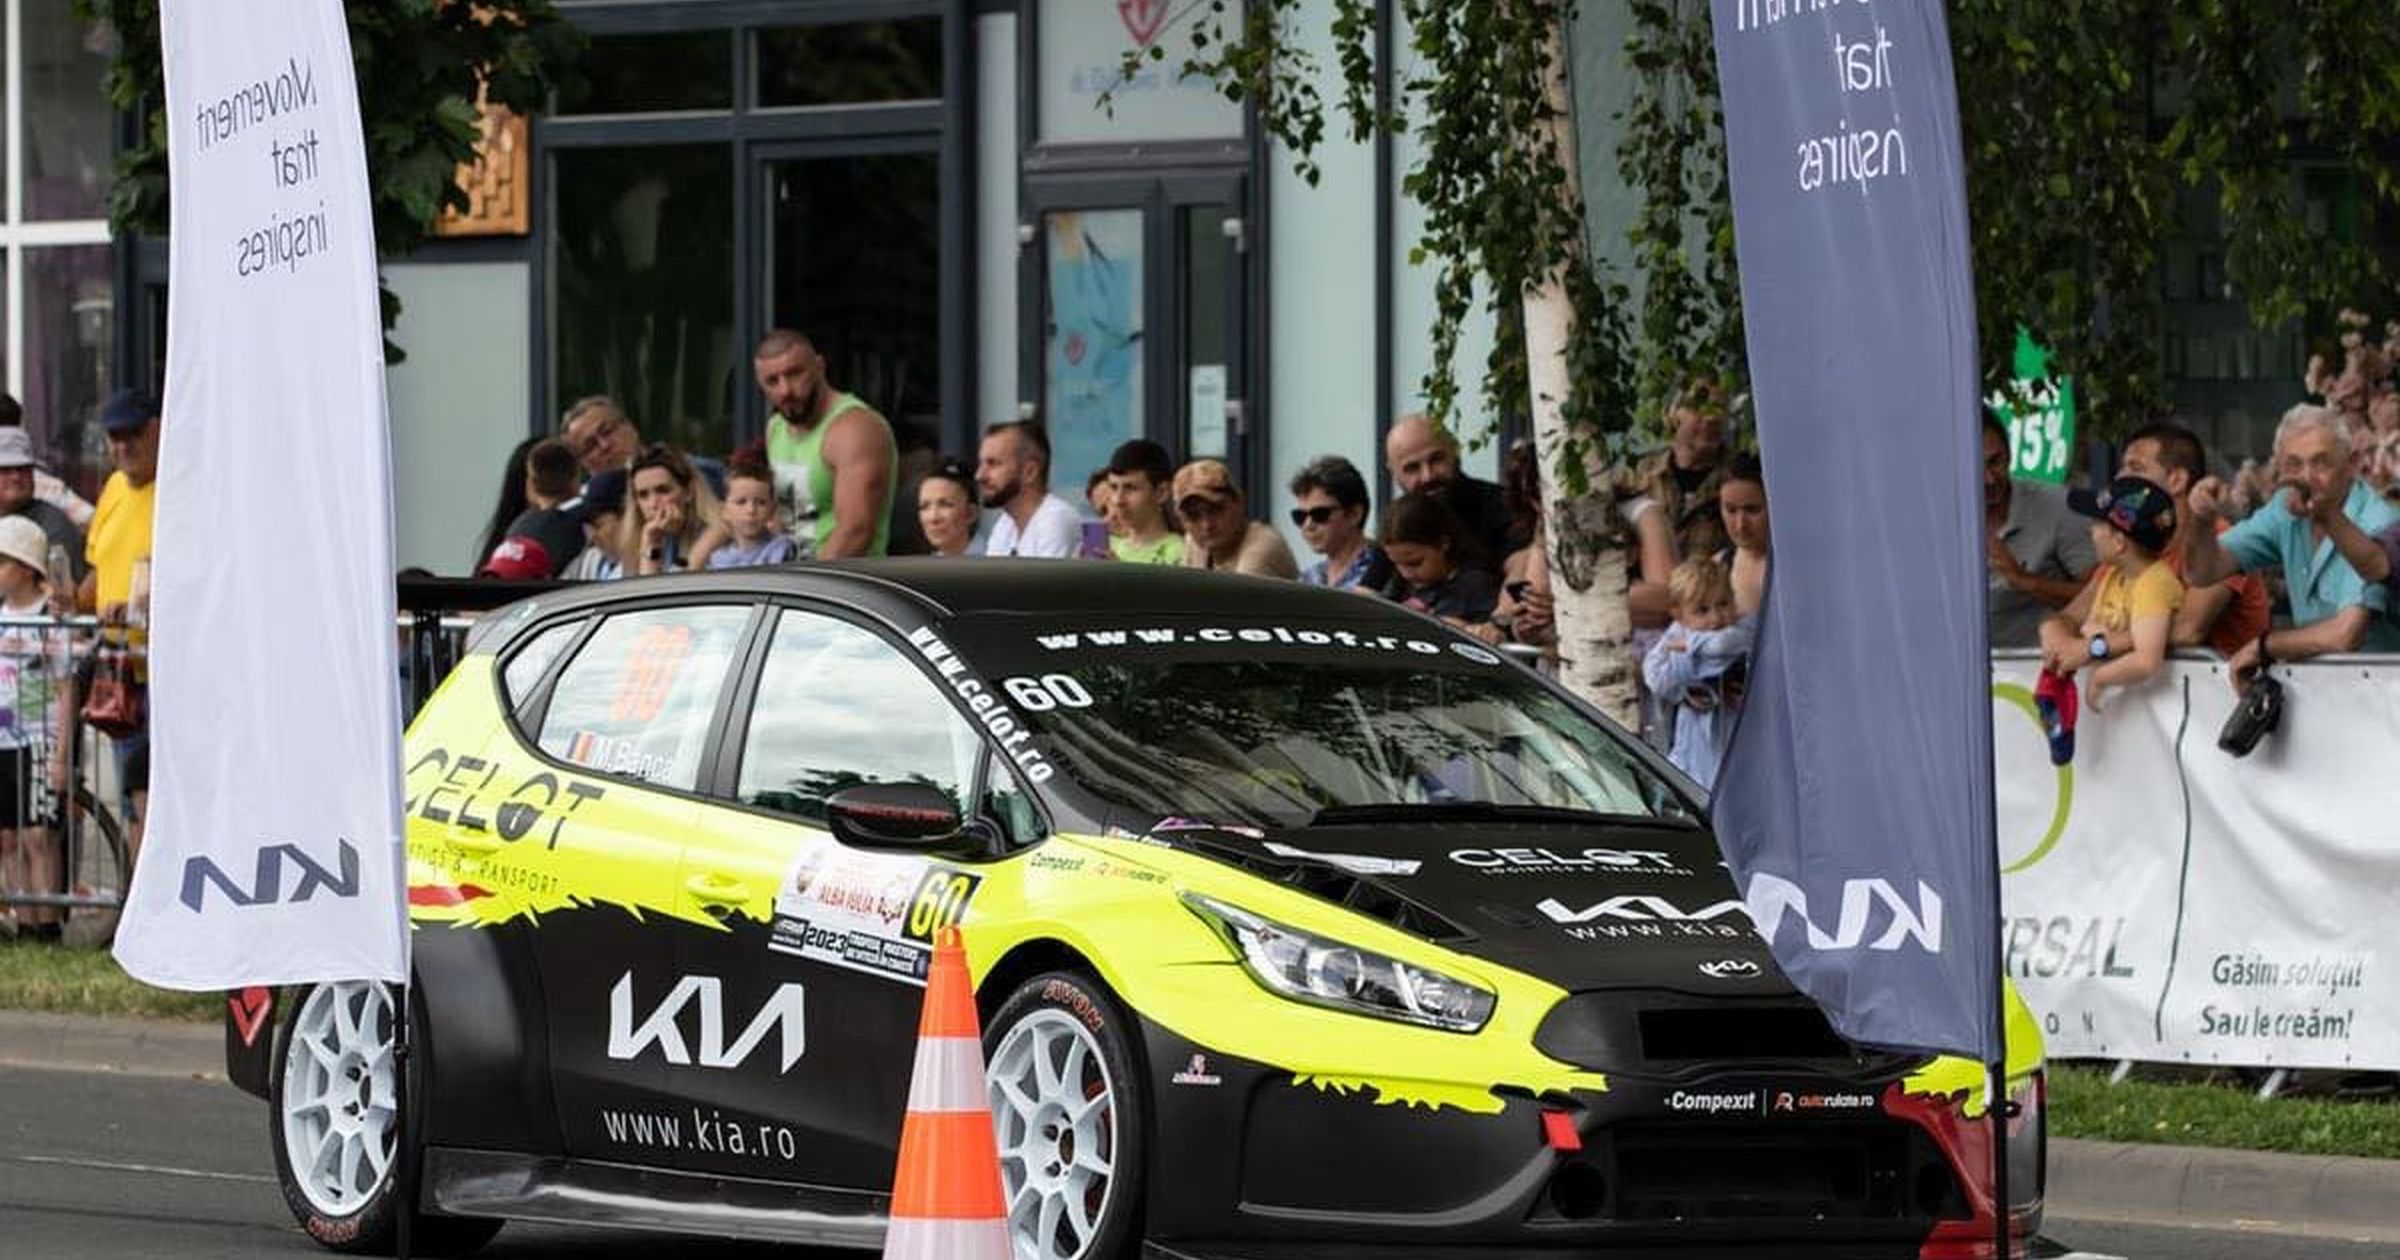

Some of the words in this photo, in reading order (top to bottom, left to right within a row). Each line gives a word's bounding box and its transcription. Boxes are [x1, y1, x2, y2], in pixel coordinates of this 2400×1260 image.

[1036, 627, 1440, 654] www.celot.ro
[909, 626, 1054, 782] www.celot.ro
[1003, 674, 1094, 711] 60
[1449, 848, 1674, 868] CELOT
[910, 871, 971, 938] 60
[804, 926, 849, 954] 2023
[2002, 915, 2137, 979] RSAL
[607, 968, 805, 1075] KIA
[2199, 1006, 2249, 1036] Sau
[2252, 1007, 2270, 1036] le
[1671, 1090, 1756, 1114] Compexit
[603, 1106, 797, 1160] www.kia.ro
